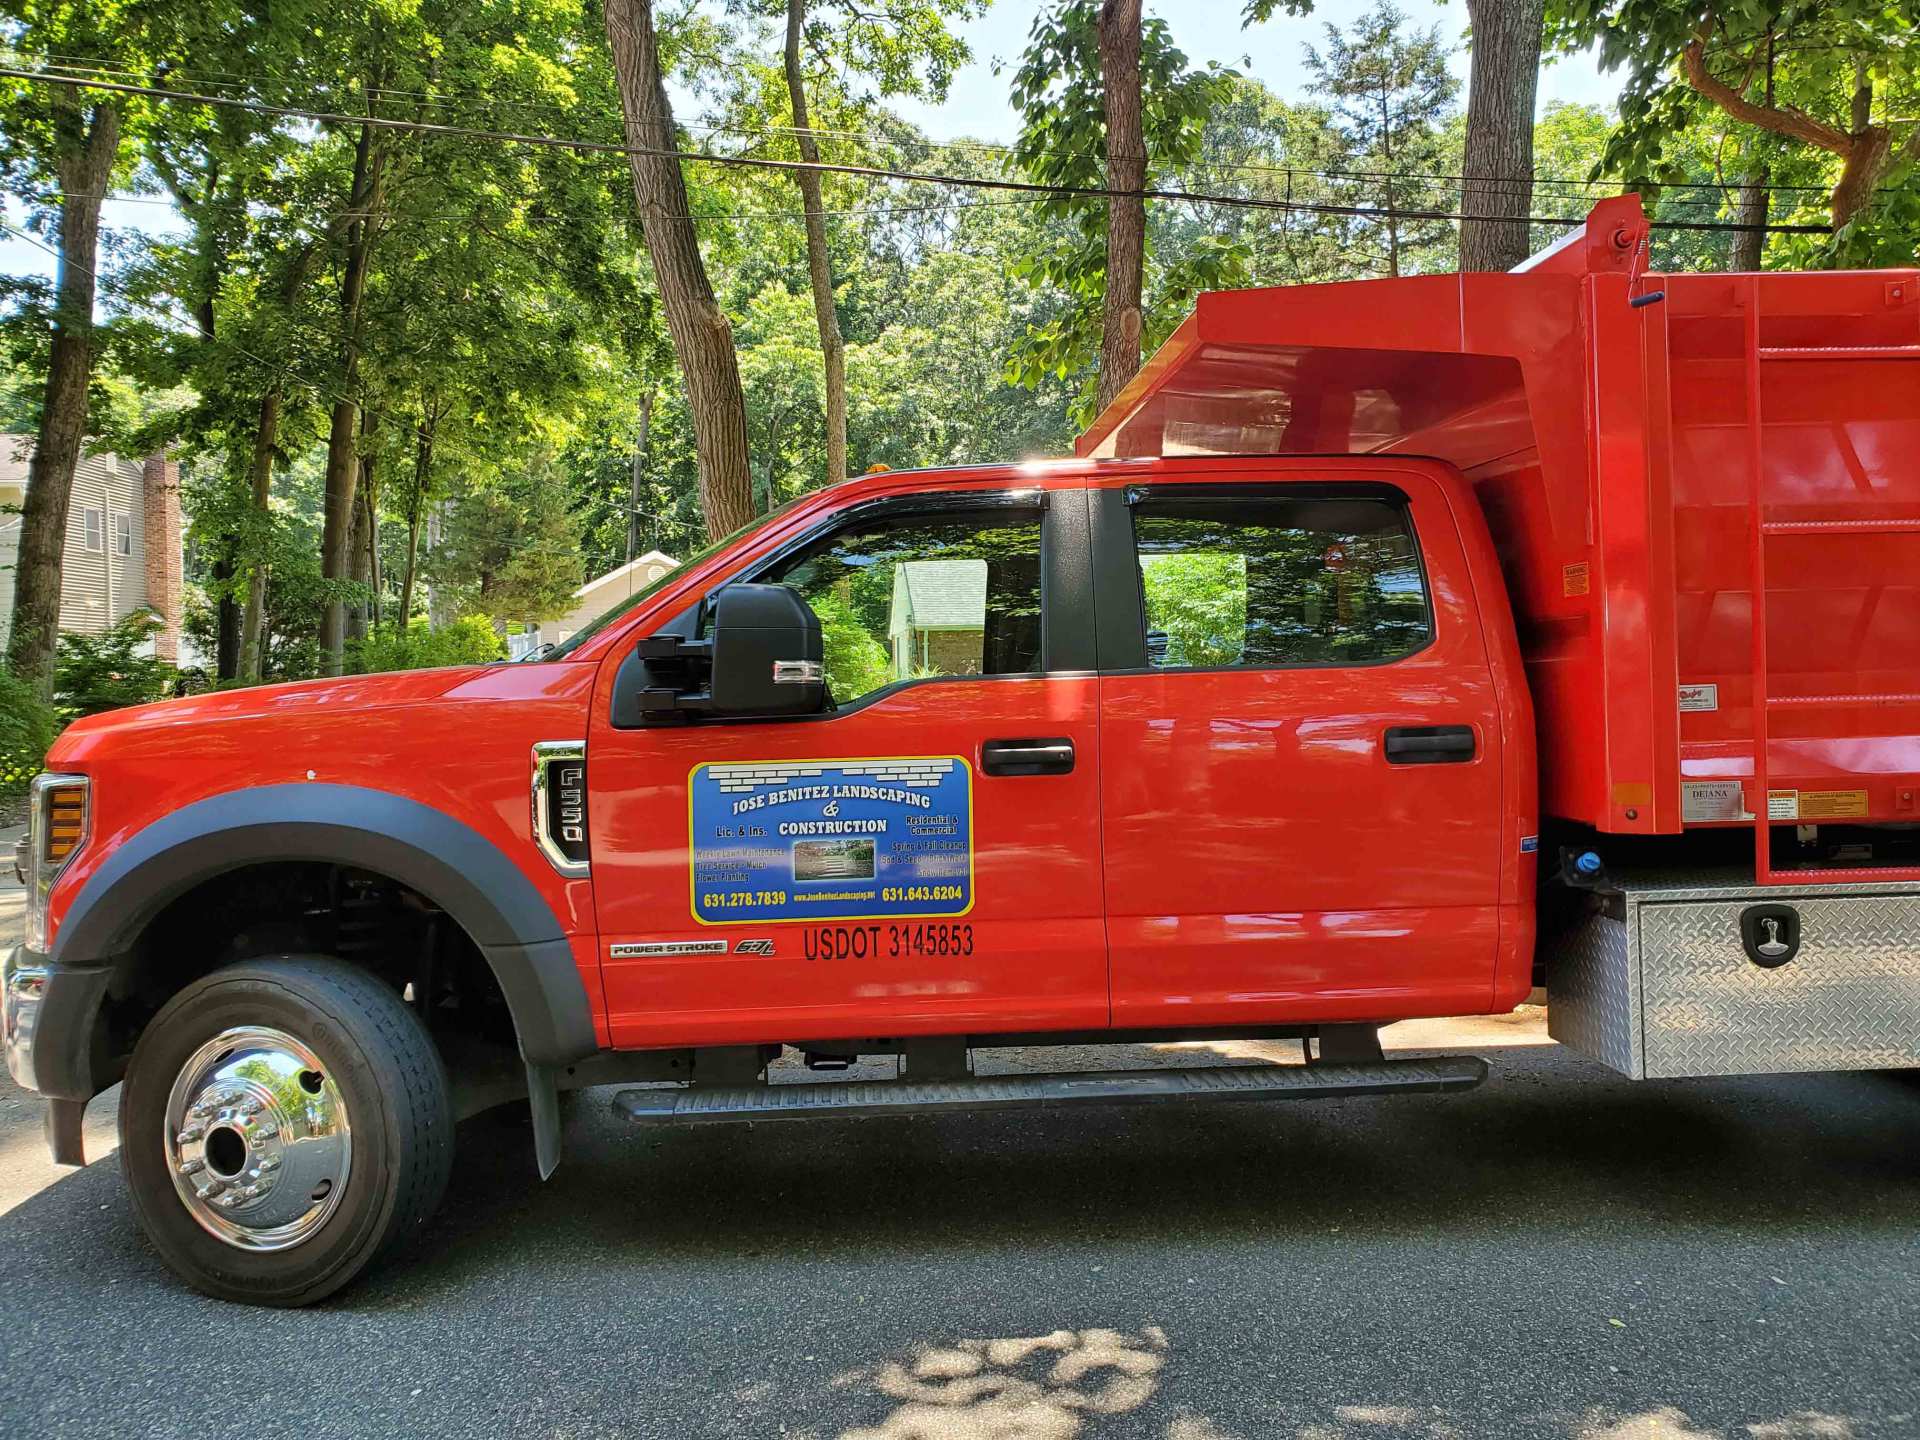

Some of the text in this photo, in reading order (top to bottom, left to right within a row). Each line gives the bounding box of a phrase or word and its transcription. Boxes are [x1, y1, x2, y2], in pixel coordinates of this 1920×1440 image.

[732, 785, 930, 815] JOSE BENITEZ LANDSCAPING
[1692, 790, 1728, 799] DEJANA
[823, 800, 839, 816] &
[906, 814, 950, 825] Residential
[716, 825, 767, 837] Lic. & Ins.
[779, 820, 887, 835] CONSTRUCTION
[911, 826, 957, 836] Commercial
[704, 891, 786, 907] 631.278.7839
[882, 886, 962, 901] 631.643.6204
[614, 944, 666, 954] POWER
[667, 942, 723, 952] STROKE
[804, 924, 973, 960] USDOT 3145853
